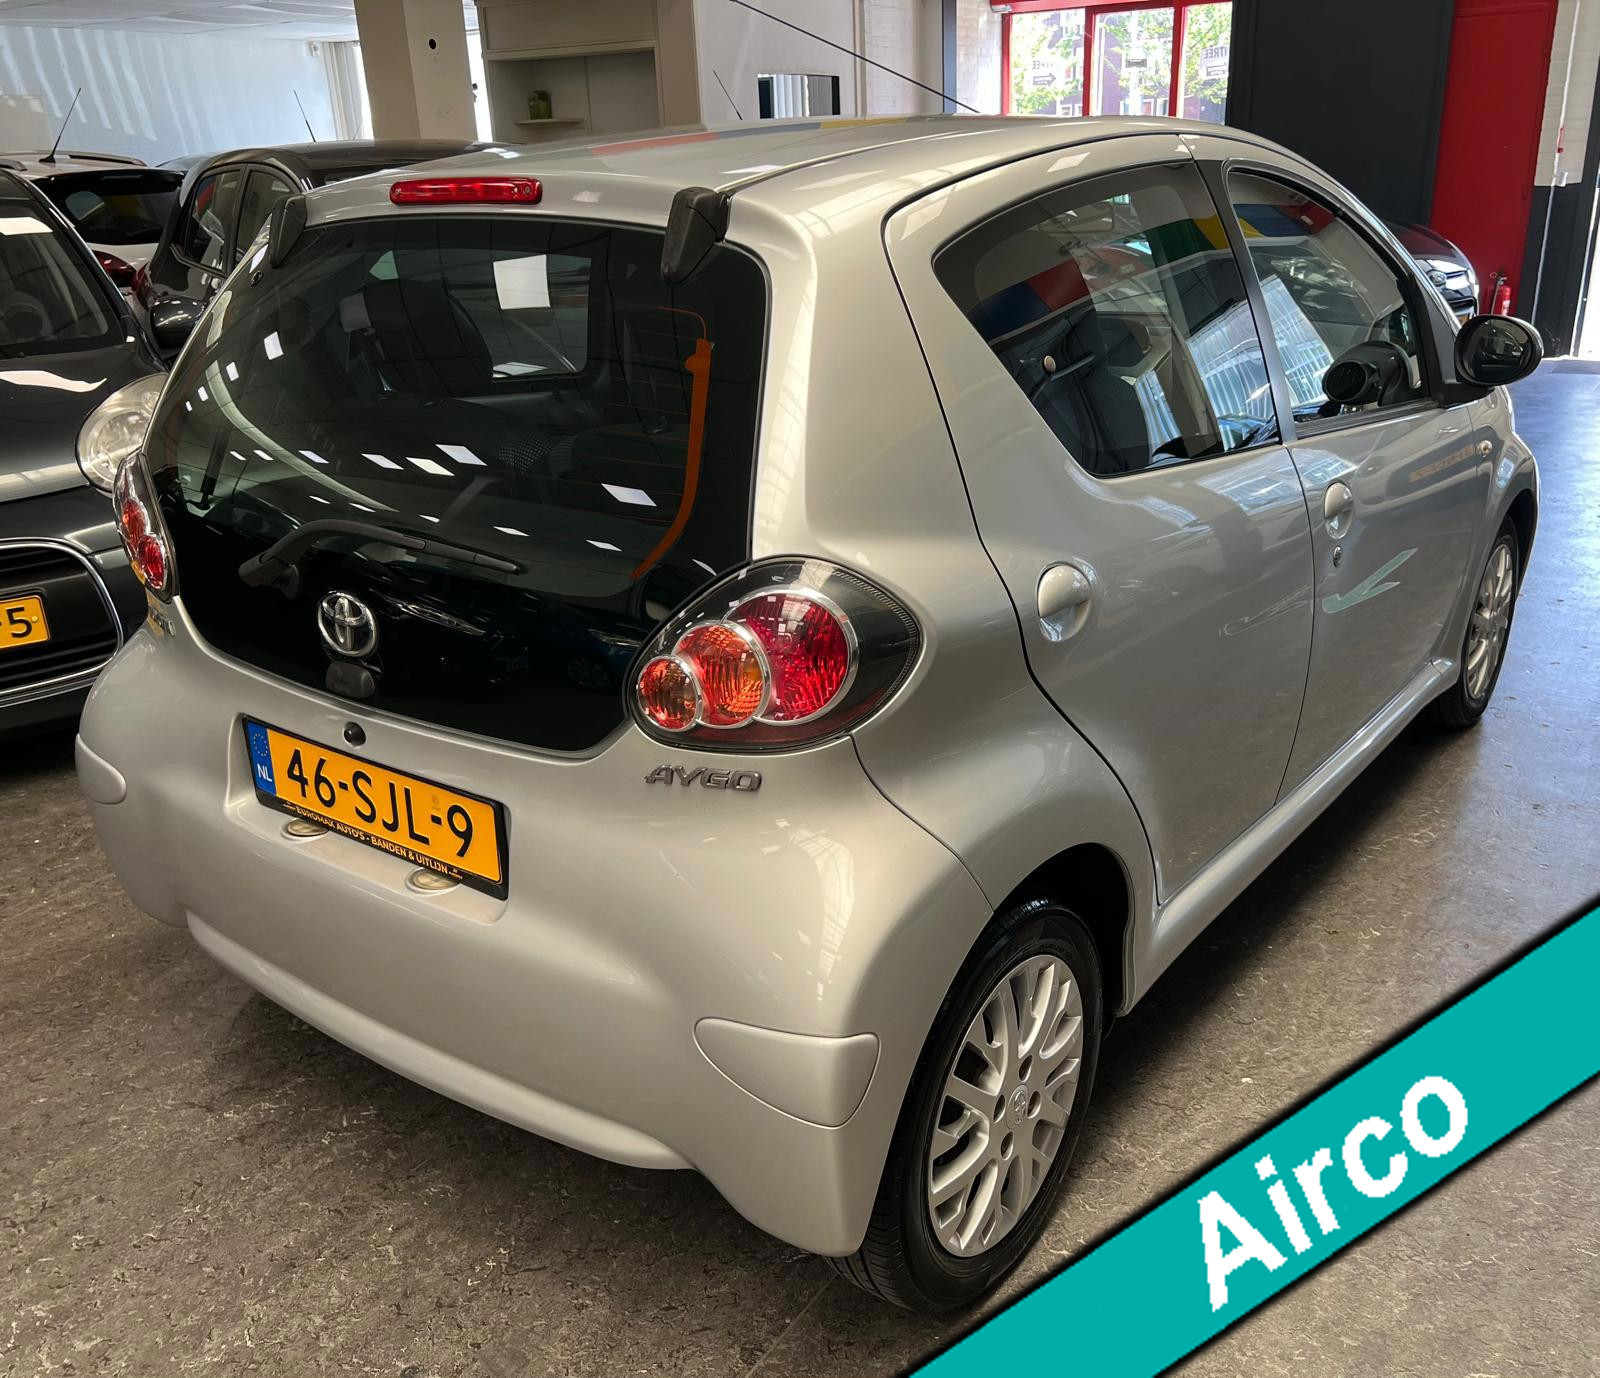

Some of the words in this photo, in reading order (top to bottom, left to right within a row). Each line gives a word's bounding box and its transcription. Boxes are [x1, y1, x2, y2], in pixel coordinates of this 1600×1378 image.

[0, 607, 32, 638] 5
[256, 763, 272, 782] NL
[644, 764, 762, 792] AYGO
[287, 749, 473, 858] 46-SJL-9
[336, 823, 365, 841] AUTO'S
[371, 836, 407, 857] BANDEN
[408, 850, 415, 861] &
